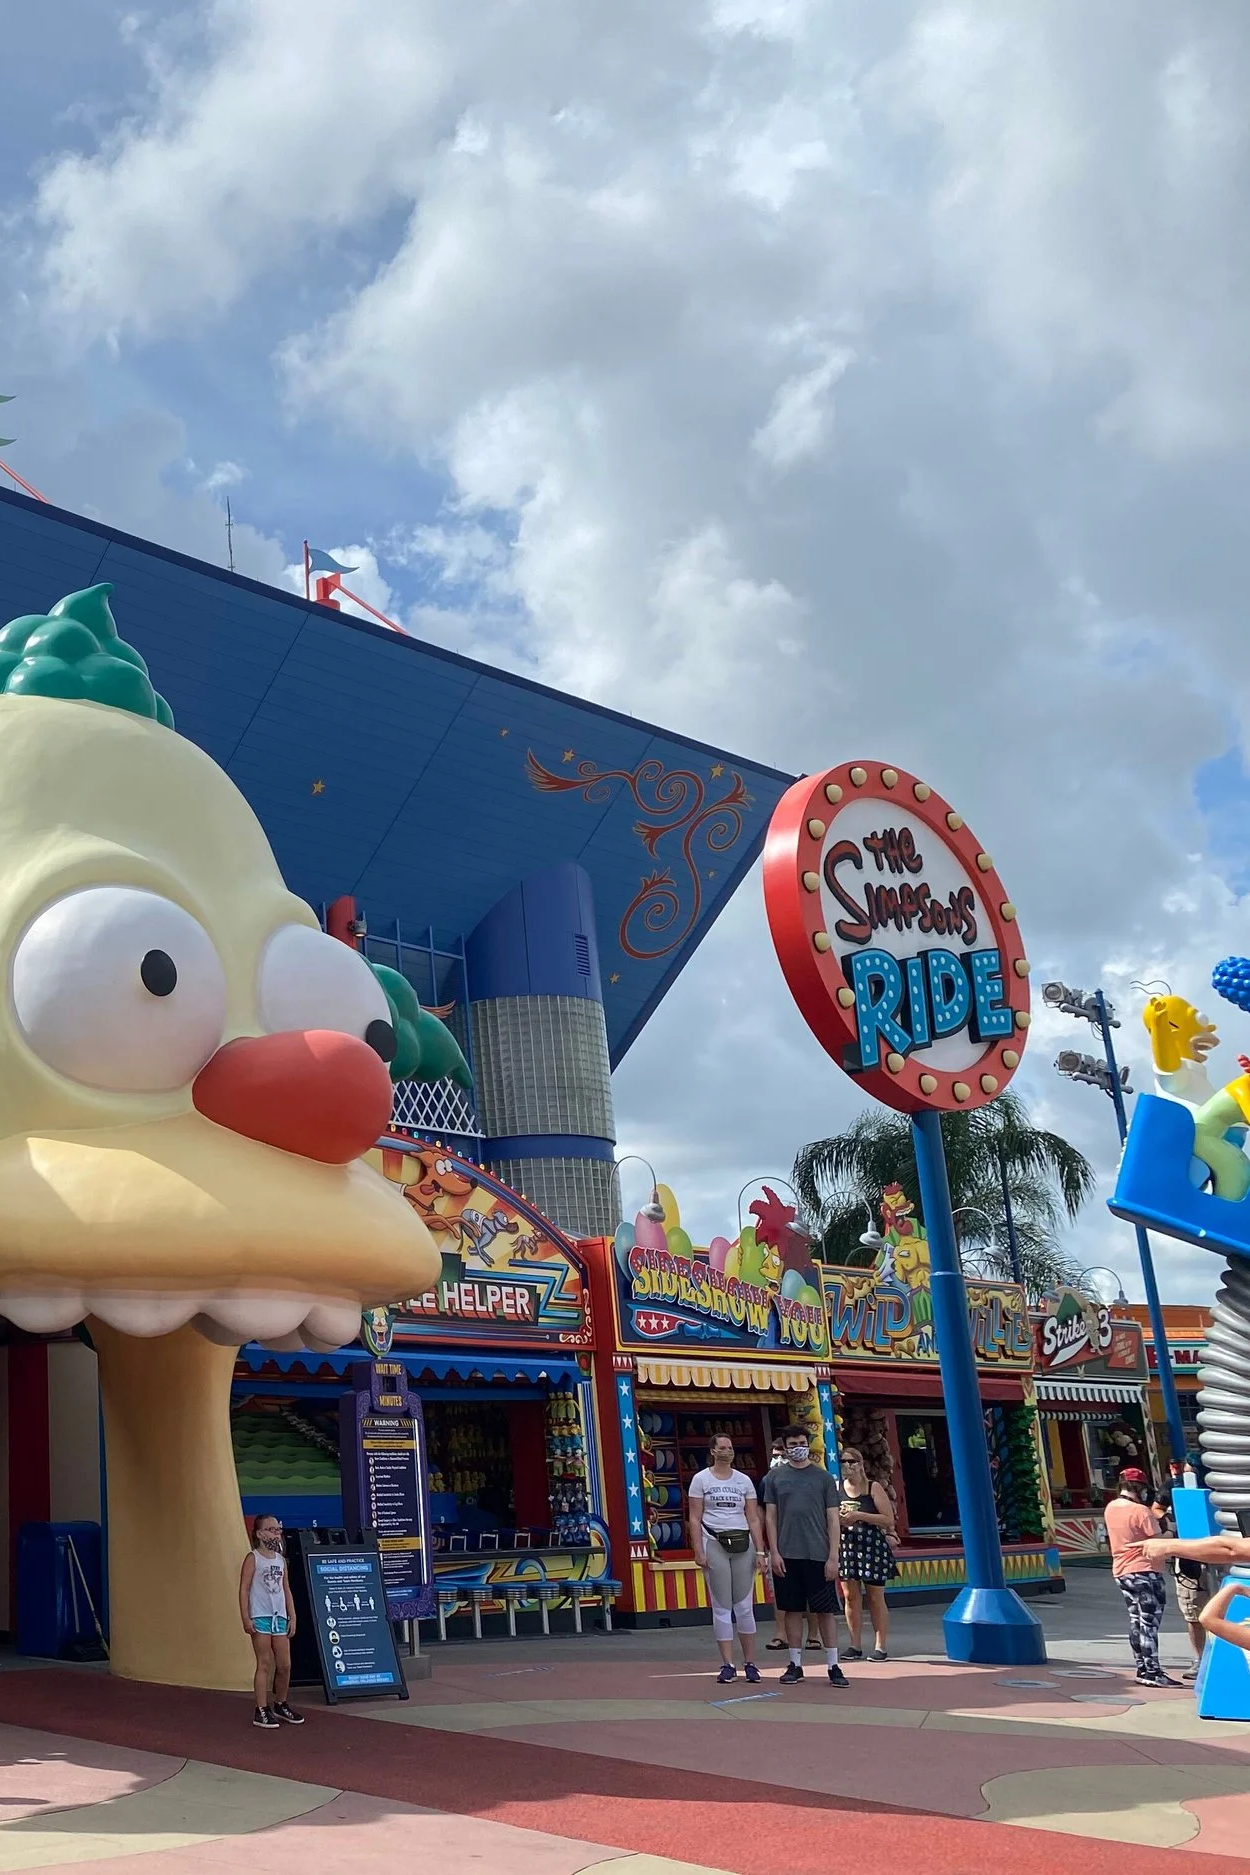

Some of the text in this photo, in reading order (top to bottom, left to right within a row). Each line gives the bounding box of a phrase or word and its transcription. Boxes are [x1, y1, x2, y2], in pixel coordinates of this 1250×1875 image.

[842, 948, 1015, 1075] RIDE
[442, 1281, 531, 1317] HELPER
[629, 1246, 826, 1350] SIDESHOW YOU
[917, 1332, 940, 1358] AN
[1043, 1314, 1088, 1356] Strike
[1098, 1309, 1112, 1347] 3
[375, 1363, 402, 1376] WAIT TIME
[379, 1395, 403, 1407] MINUTES
[373, 1419, 400, 1427] WARNING
[312, 1519, 318, 1528] 5
